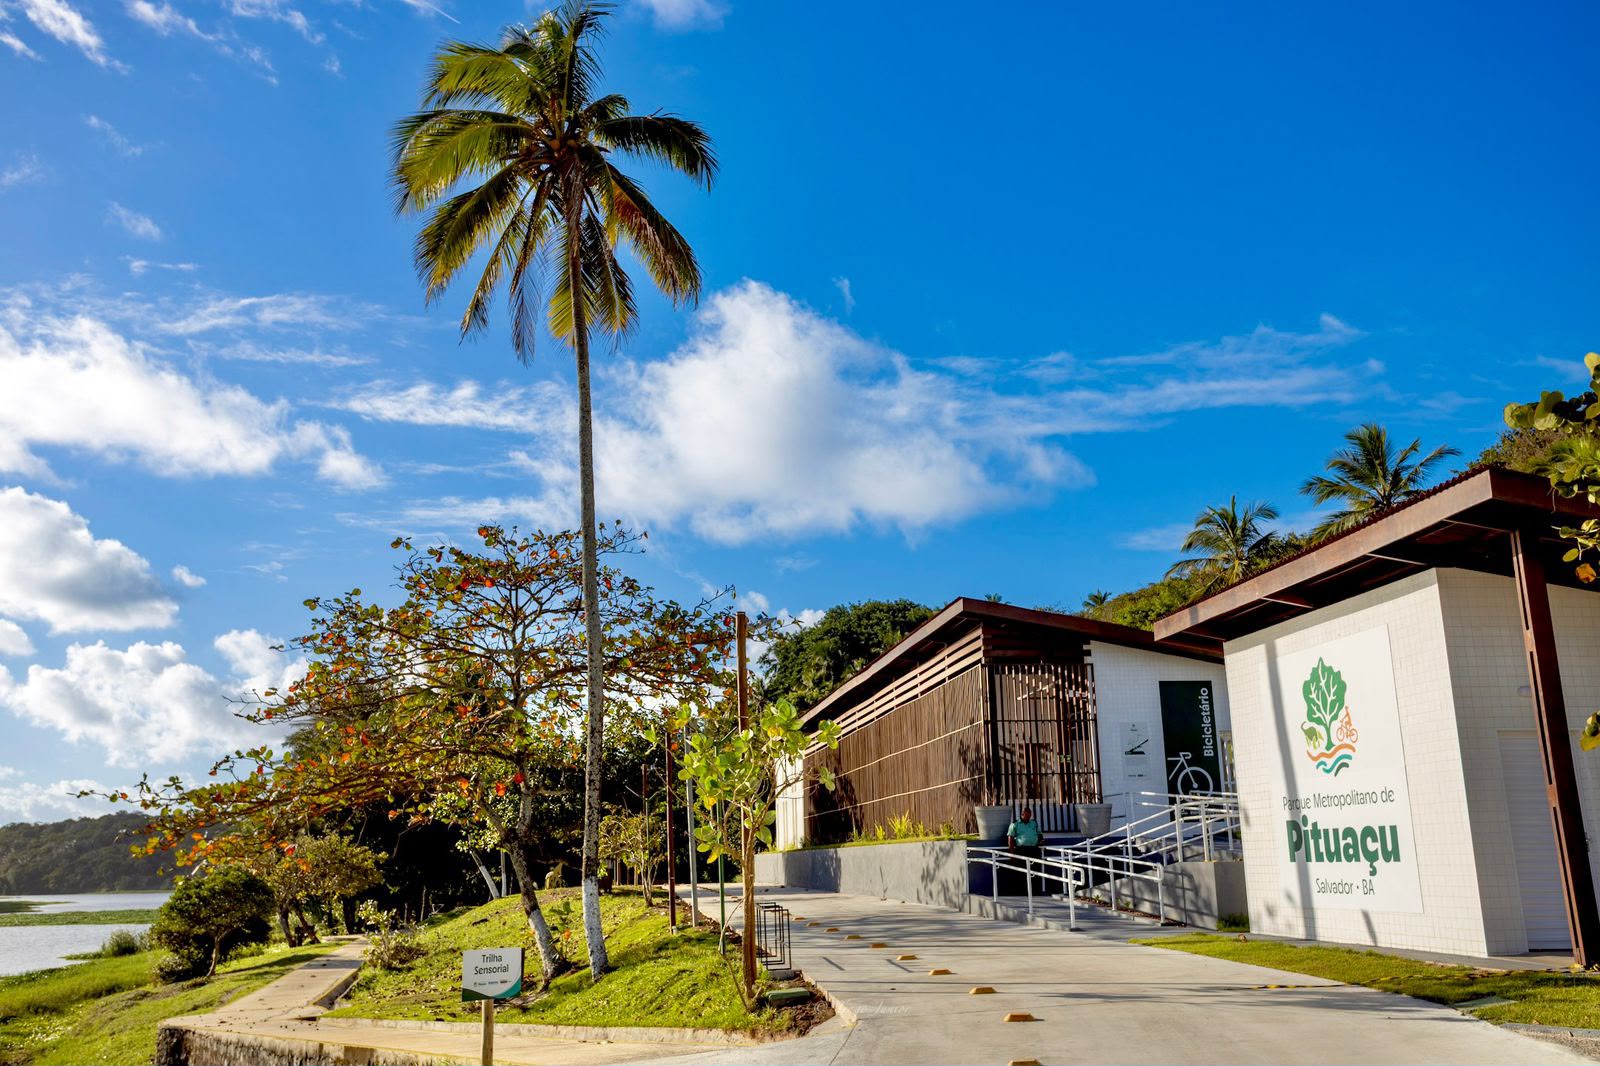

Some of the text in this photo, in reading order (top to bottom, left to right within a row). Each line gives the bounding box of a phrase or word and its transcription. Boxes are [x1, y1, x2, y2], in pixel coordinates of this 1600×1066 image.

[1198, 687, 1214, 756] Bicicletário
[1282, 786, 1395, 811] Parque Metropolitano de
[1286, 814, 1401, 876] Pituaçu
[1316, 877, 1354, 895] Salvador
[1362, 878, 1375, 896] BA
[481, 953, 502, 963] Trilha
[474, 964, 509, 975] Sensorial
